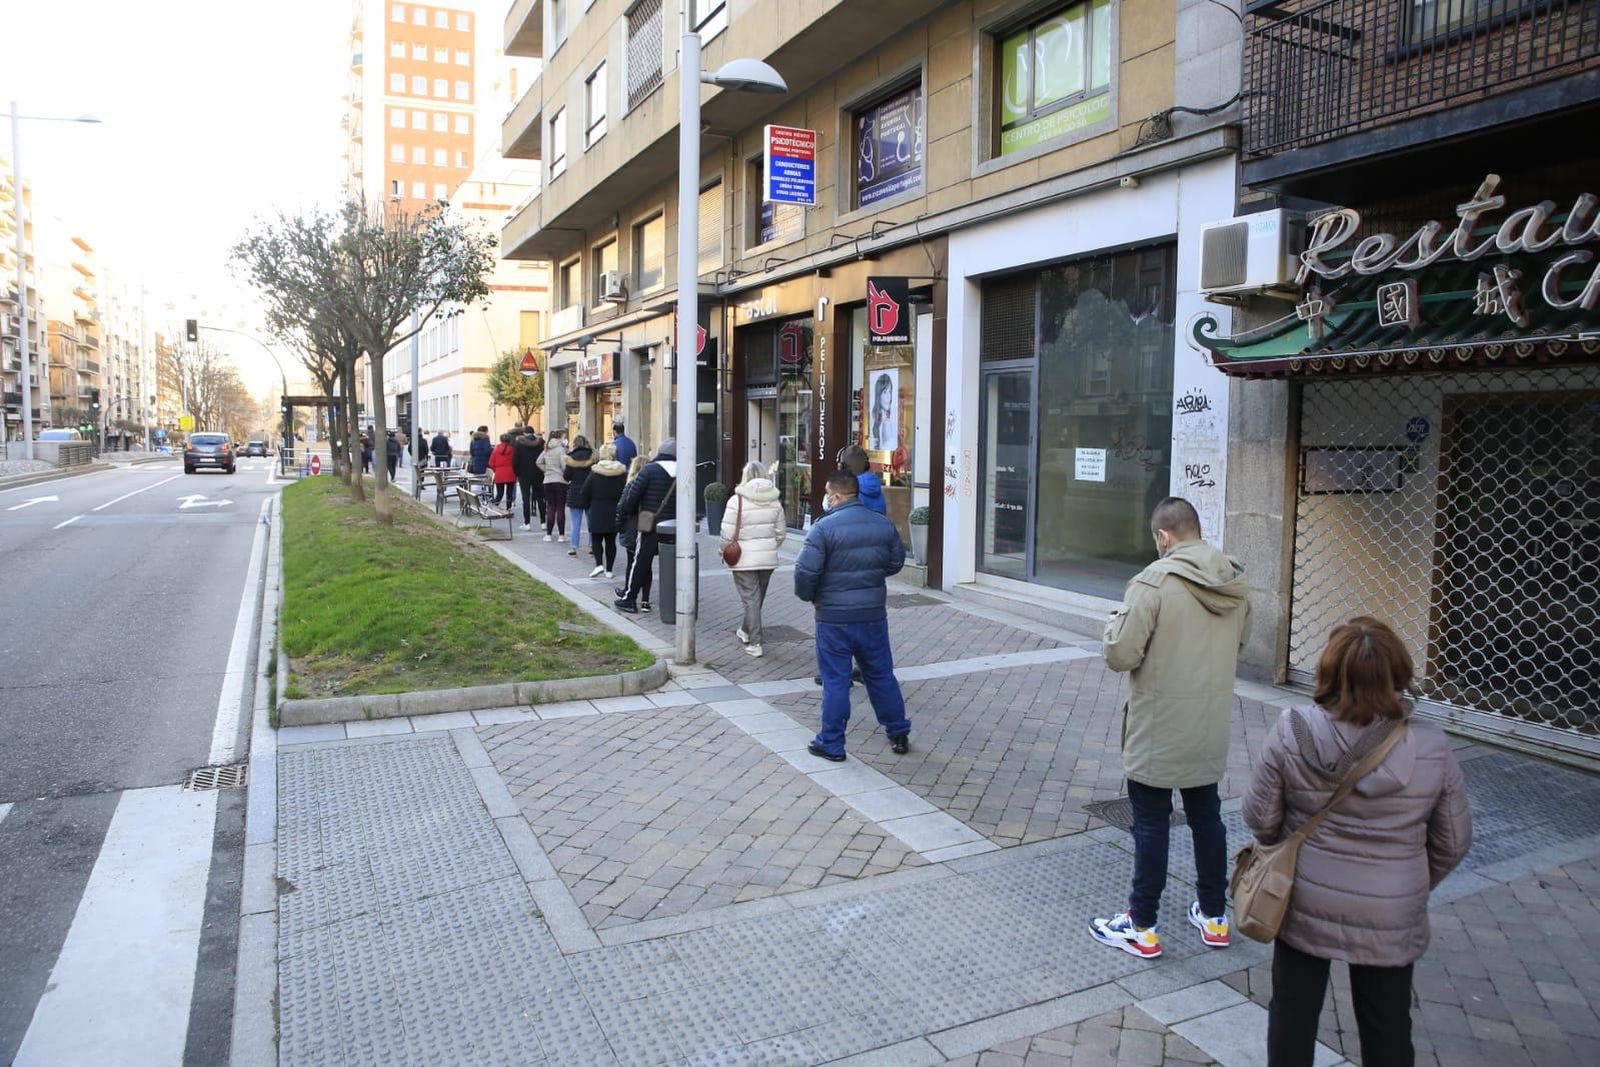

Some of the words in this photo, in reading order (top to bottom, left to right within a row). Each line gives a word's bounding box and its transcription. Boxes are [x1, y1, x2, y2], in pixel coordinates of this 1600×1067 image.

[1296, 264, 1530, 338] 中國城
[818, 336, 827, 461] PELUQUEROS
